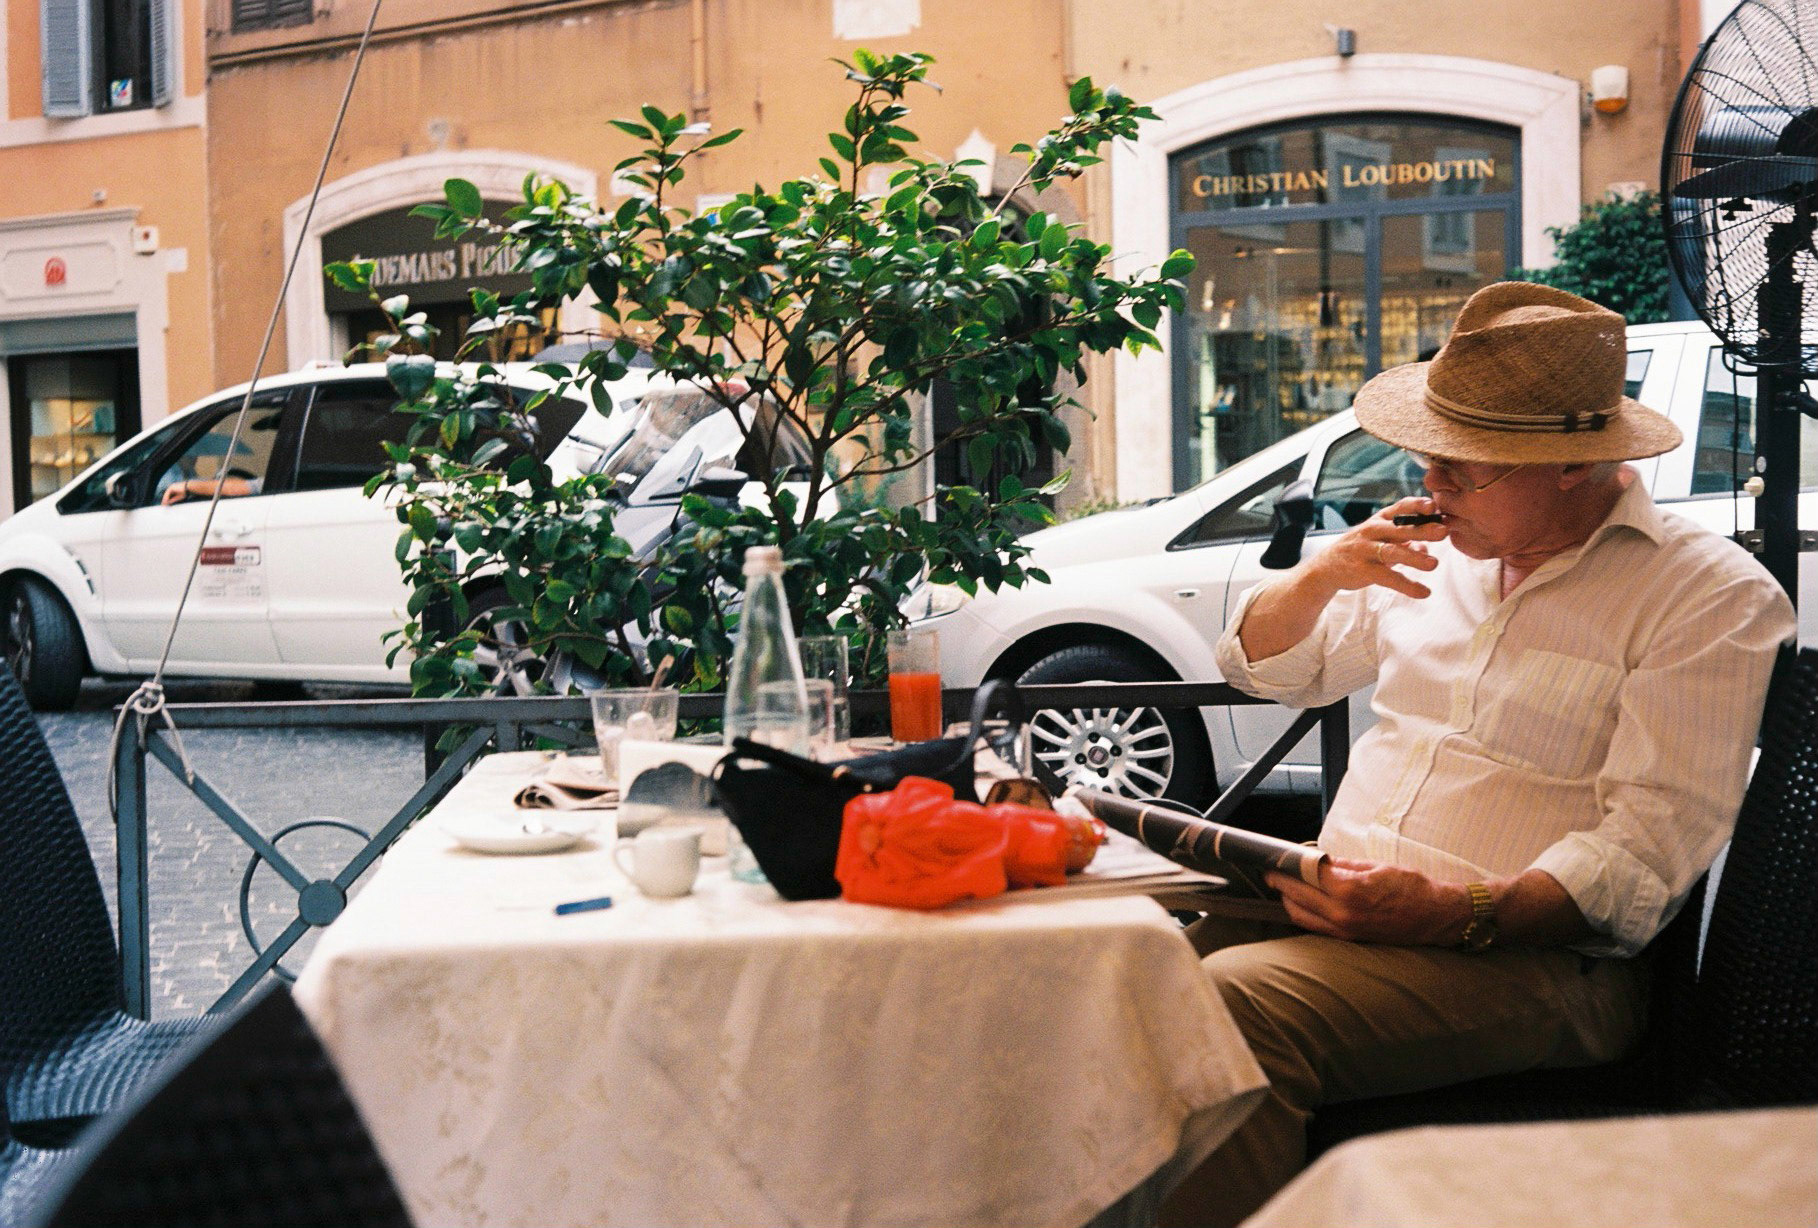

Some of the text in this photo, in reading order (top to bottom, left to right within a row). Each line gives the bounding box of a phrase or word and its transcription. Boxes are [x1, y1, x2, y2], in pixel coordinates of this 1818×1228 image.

[1193, 158, 1495, 197] CHRISTIAN LOUBOUTIN
[352, 249, 457, 287] DEMARS
